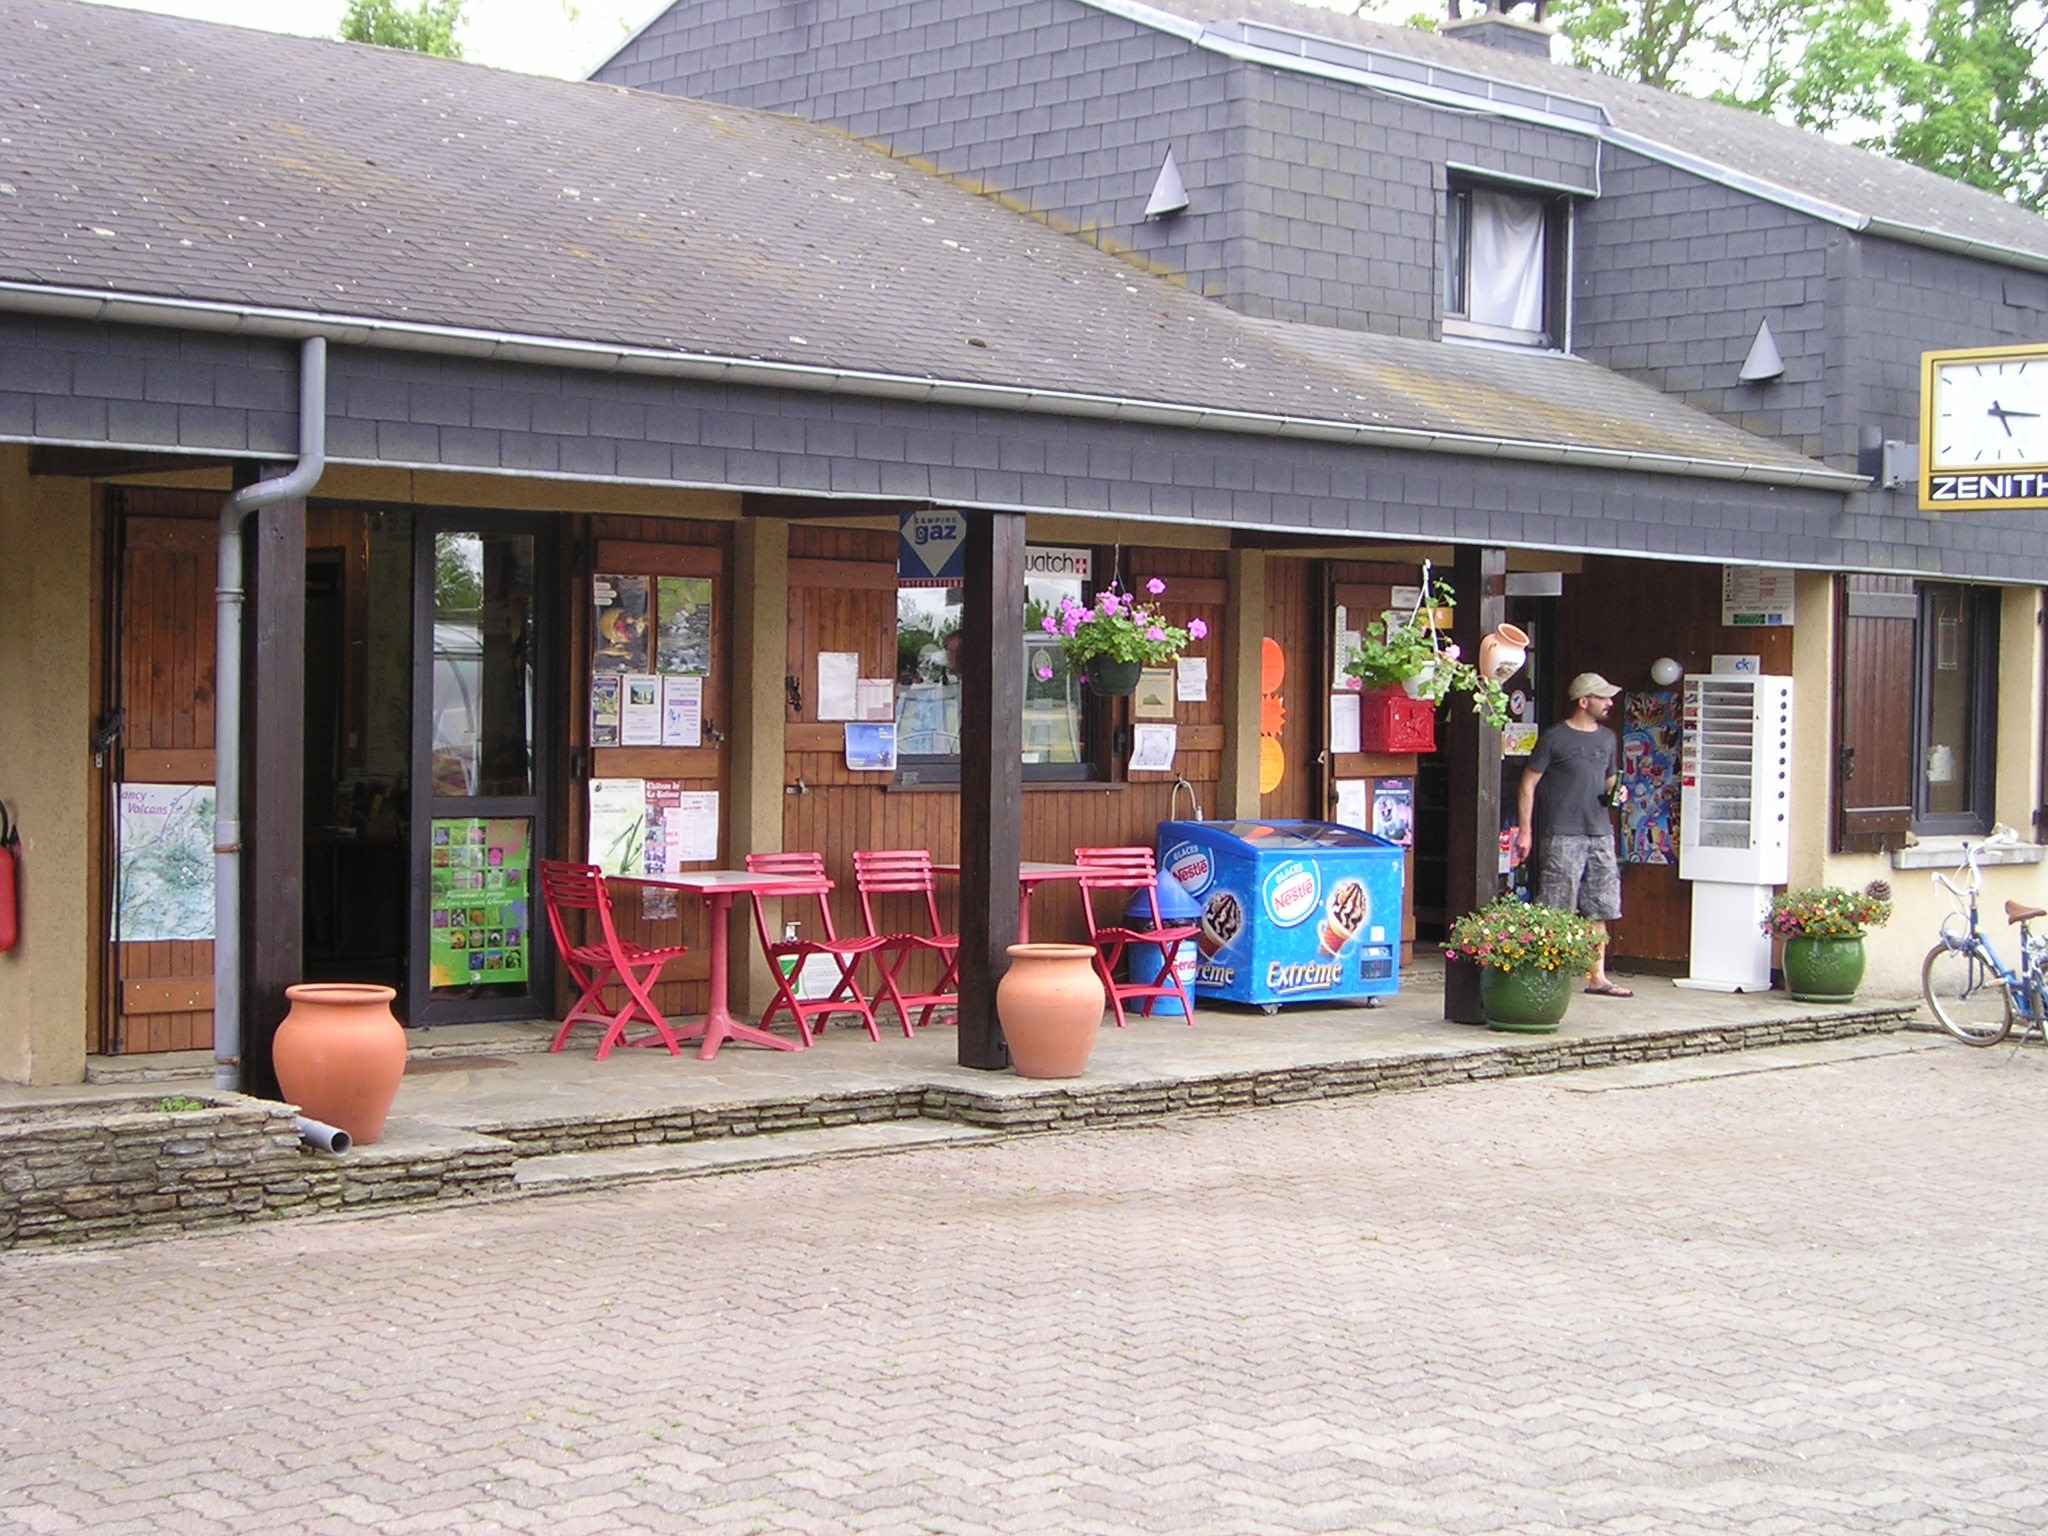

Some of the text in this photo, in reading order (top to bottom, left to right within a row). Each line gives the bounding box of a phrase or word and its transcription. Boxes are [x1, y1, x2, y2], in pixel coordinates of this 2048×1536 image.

[914, 516, 957, 524] CAMPING
[914, 524, 957, 545] gaz
[128, 802, 168, 815] Volcans
[1274, 878, 1313, 911] Nestlé
[1266, 961, 1343, 989] Extrême
